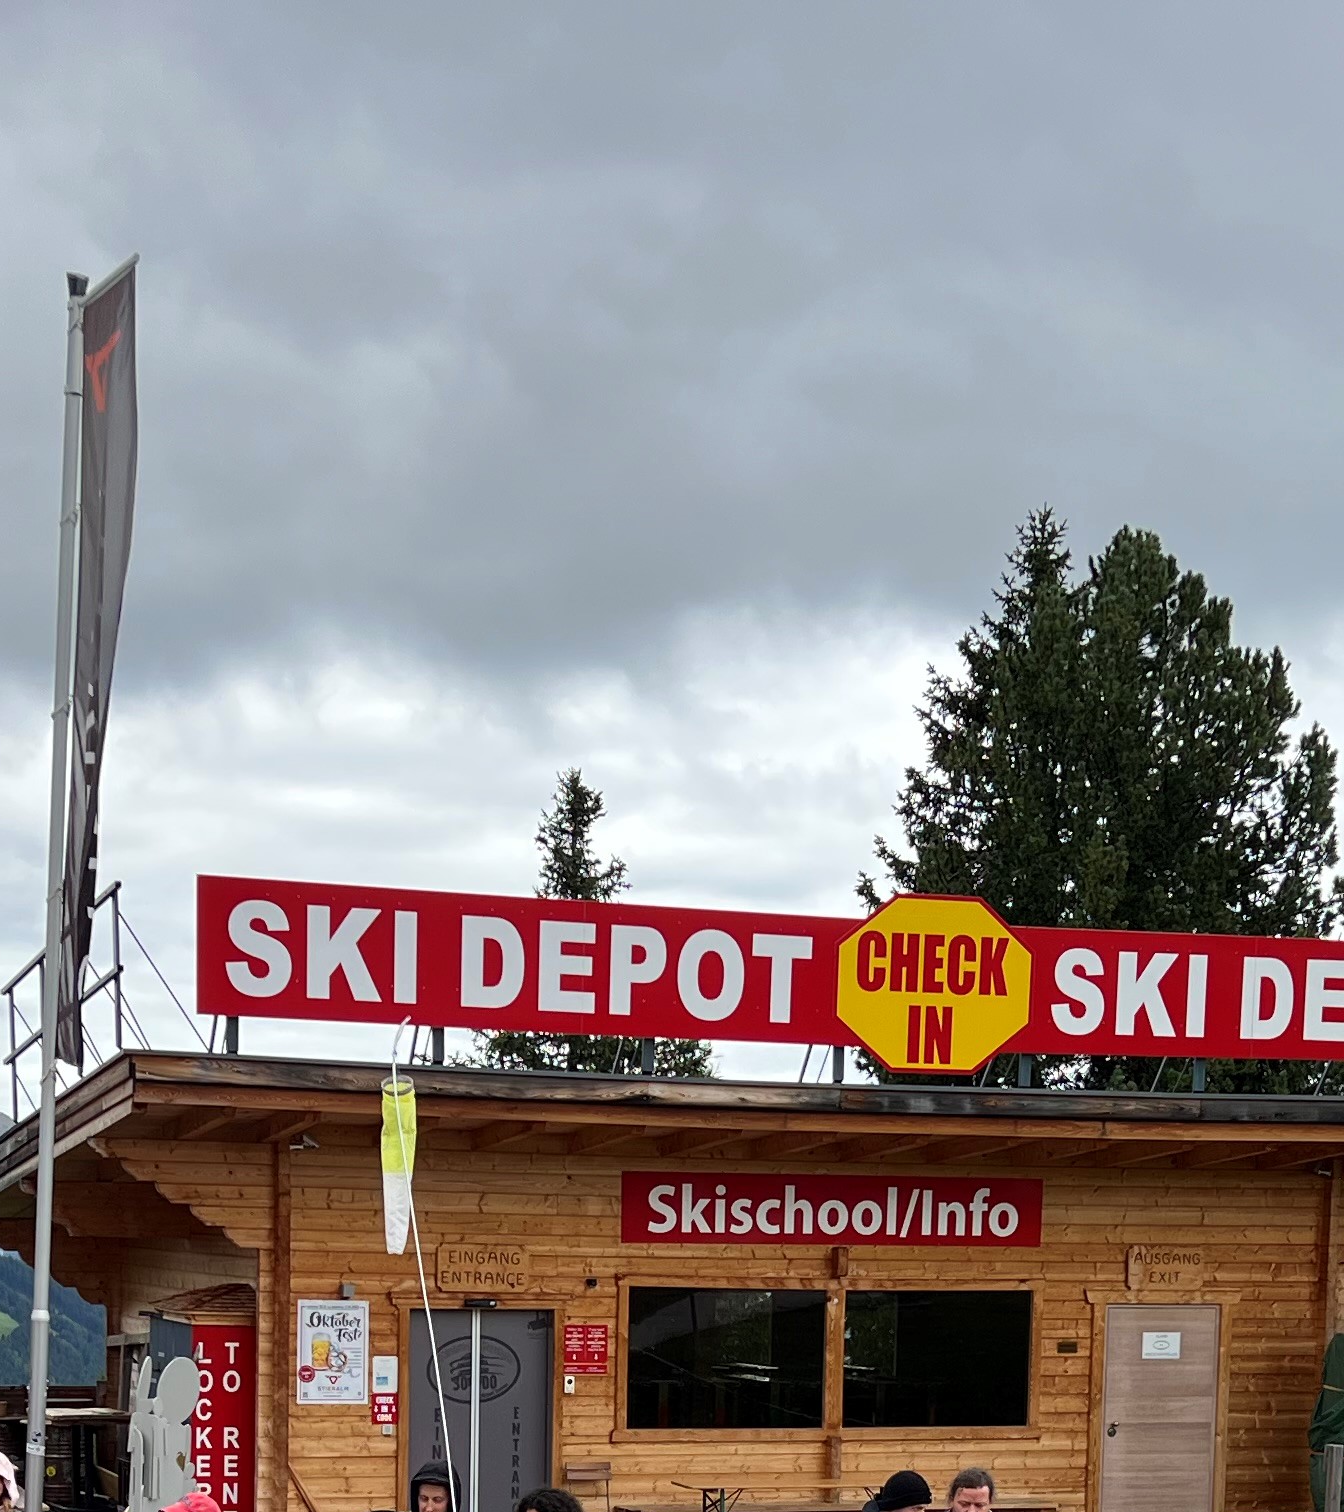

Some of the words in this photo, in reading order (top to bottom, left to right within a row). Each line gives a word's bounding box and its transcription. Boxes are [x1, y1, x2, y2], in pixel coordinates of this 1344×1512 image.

[225, 900, 418, 1004] SKI
[460, 915, 813, 1024] DEPOT
[856, 930, 1009, 997] CHECK
[1051, 947, 1209, 1038] SKI
[906, 1005, 953, 1065] IN
[647, 1183, 1019, 1238] Skischool/Info
[440, 1270, 525, 1287] ENTRANCE
[448, 1250, 521, 1265] EINGANG
[1134, 1251, 1201, 1266] AUSGANG
[1148, 1270, 1182, 1285] EXIT
[305, 1311, 361, 1328] Oktober
[222, 1342, 241, 1393] TO
